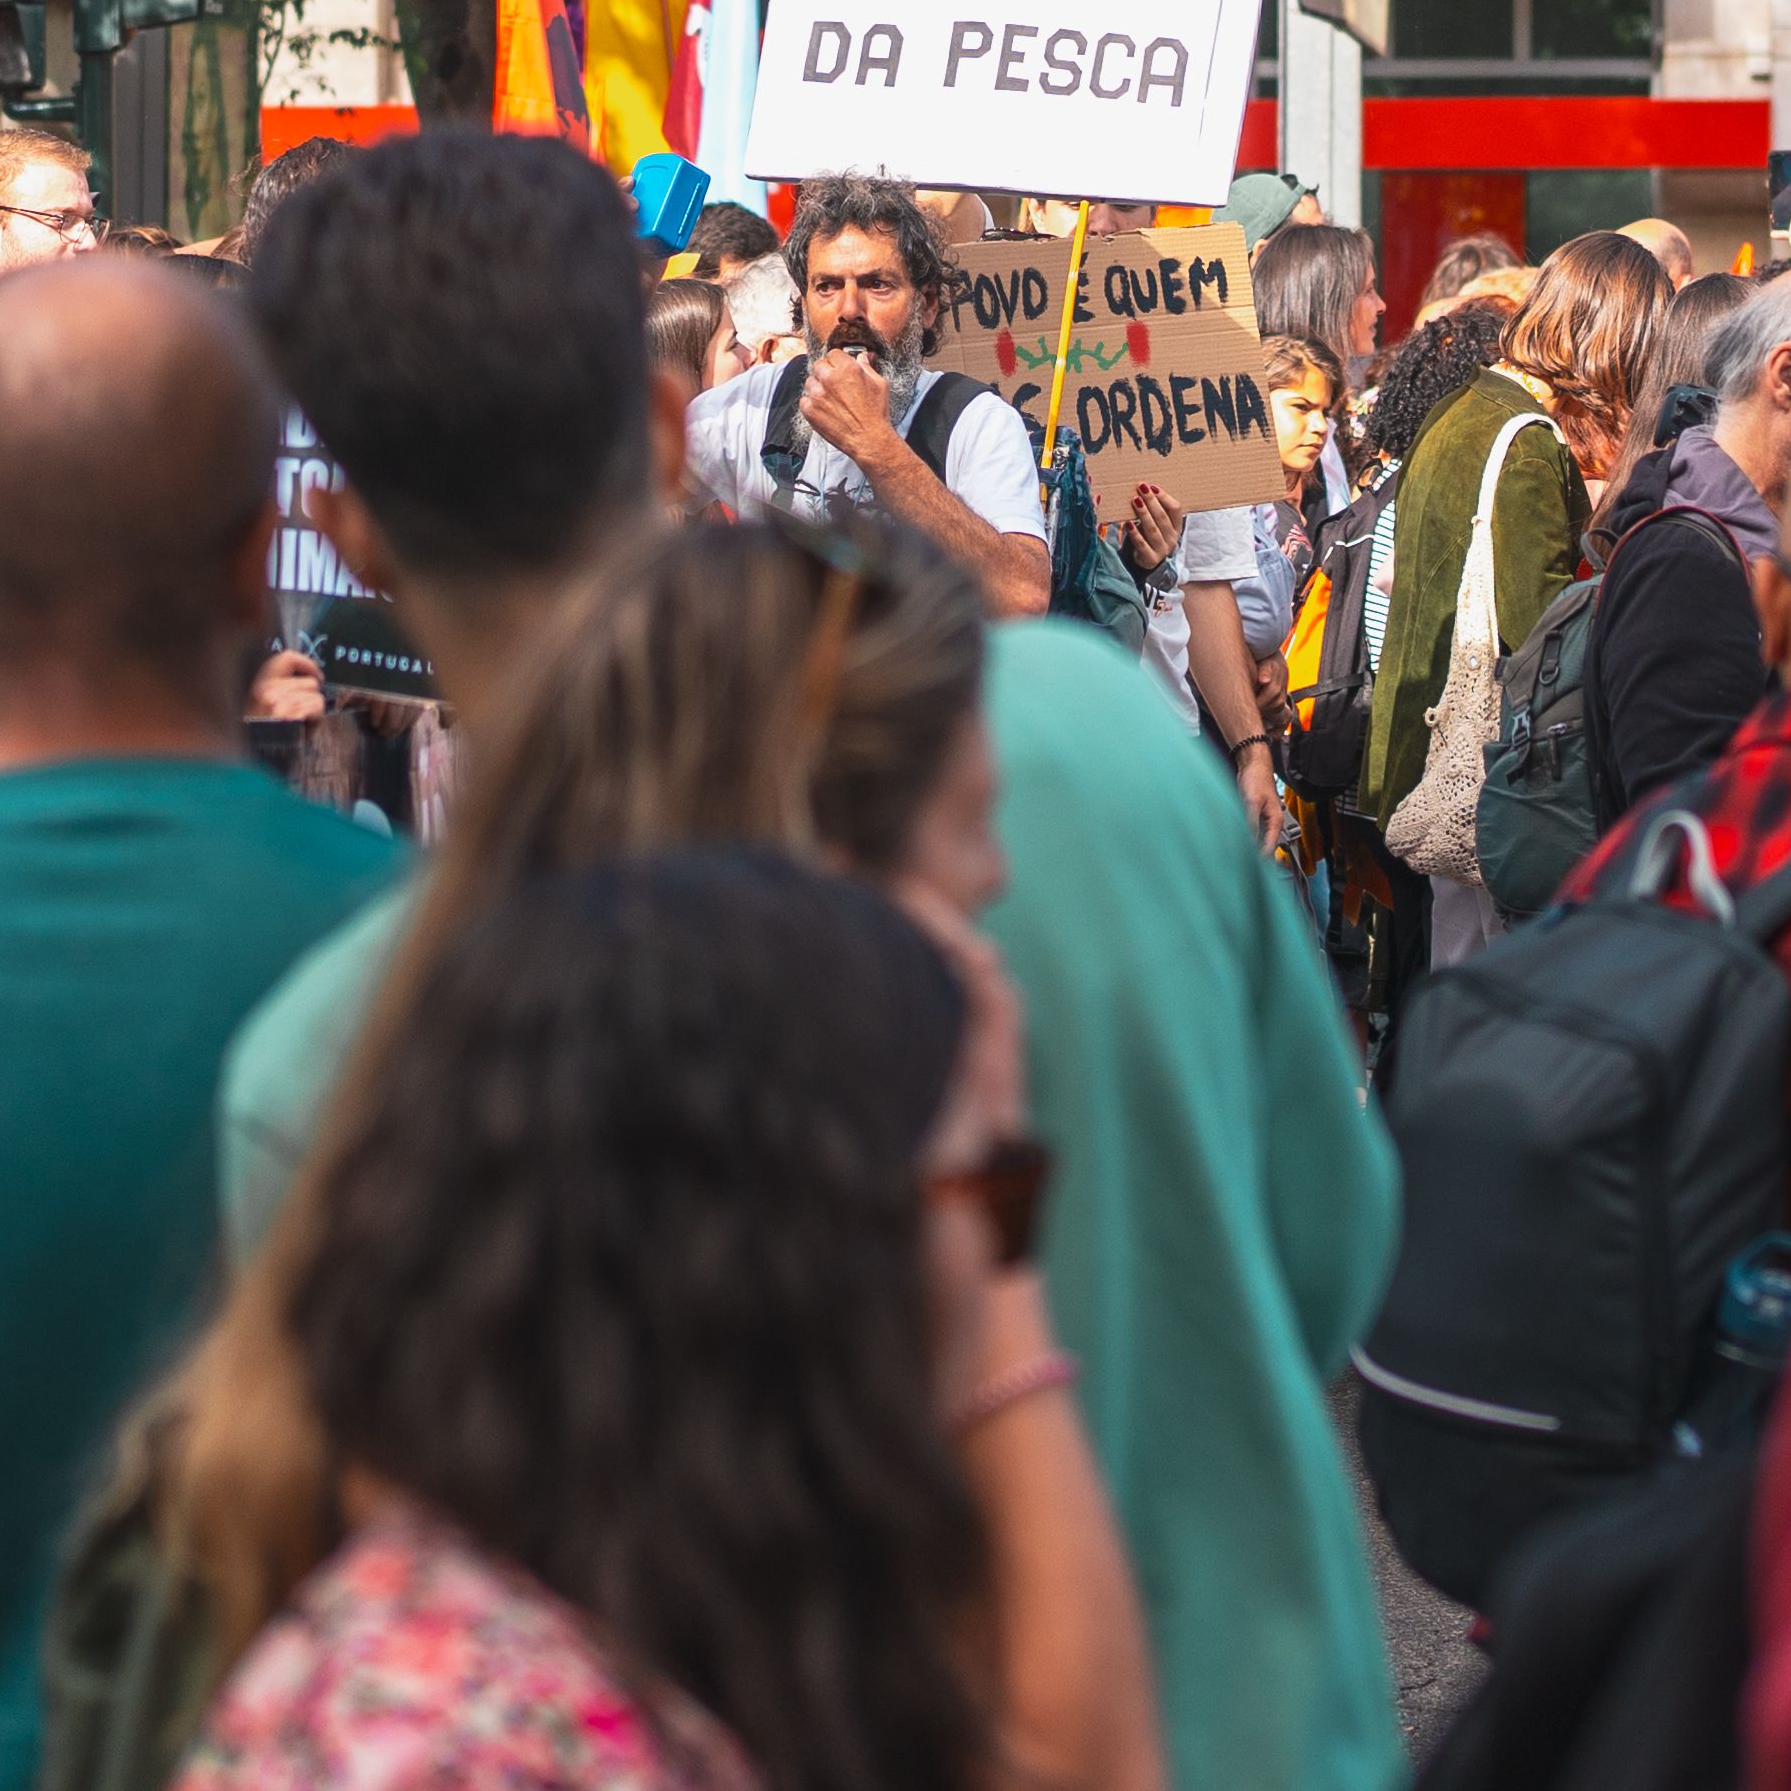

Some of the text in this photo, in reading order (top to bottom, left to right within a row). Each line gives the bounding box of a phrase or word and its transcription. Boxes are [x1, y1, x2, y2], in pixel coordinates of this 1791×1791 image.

[802, 20, 1189, 107] DA PESCA
[1105, 256, 1229, 319] QUEM
[1076, 373, 1277, 457] ORDENA
[334, 644, 435, 676] PORTUGAL
